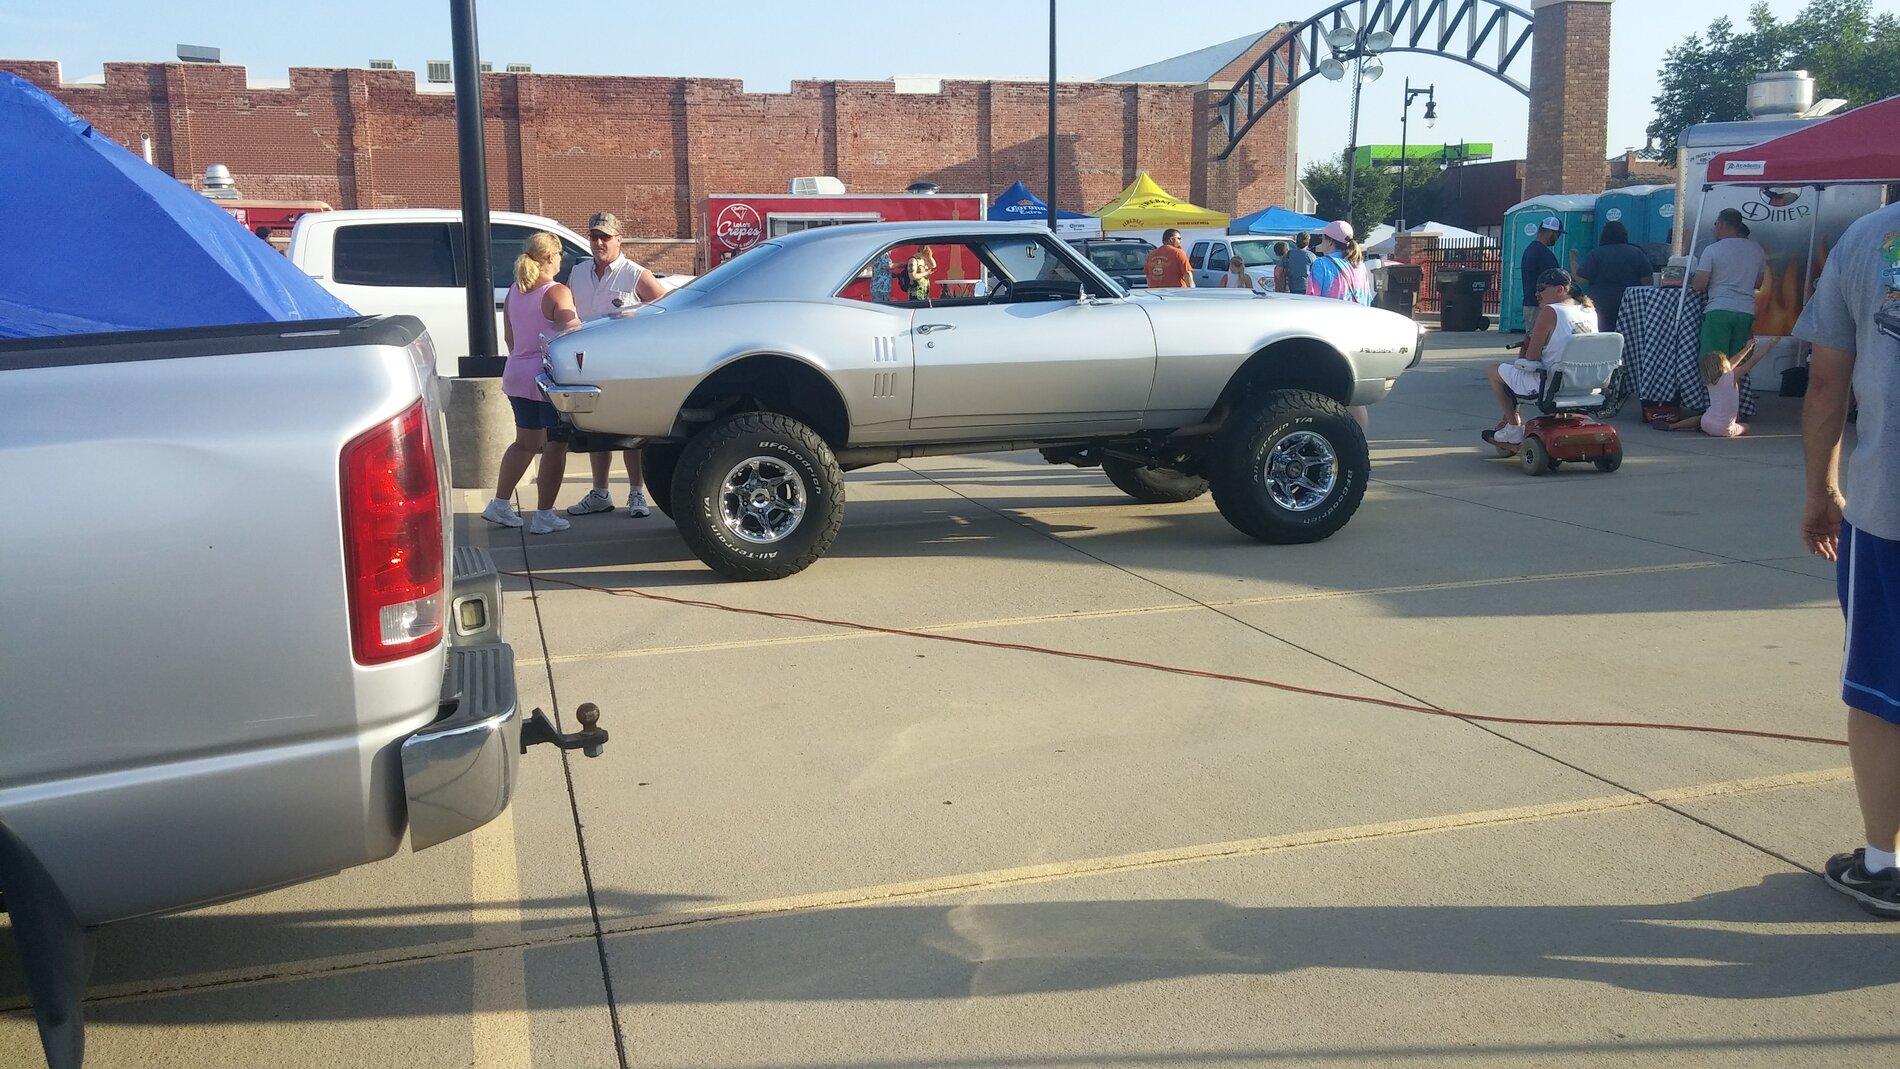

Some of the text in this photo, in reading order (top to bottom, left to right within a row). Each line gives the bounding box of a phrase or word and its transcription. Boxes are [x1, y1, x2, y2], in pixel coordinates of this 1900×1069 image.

[1005, 204, 1048, 213] Corona
[1741, 201, 1811, 222] DINER
[717, 220, 762, 241] Crepes
[1294, 416, 1314, 424] T/A
[759, 440, 822, 495] BFGoodrich
[703, 496, 778, 560] All-Terrain T/A
